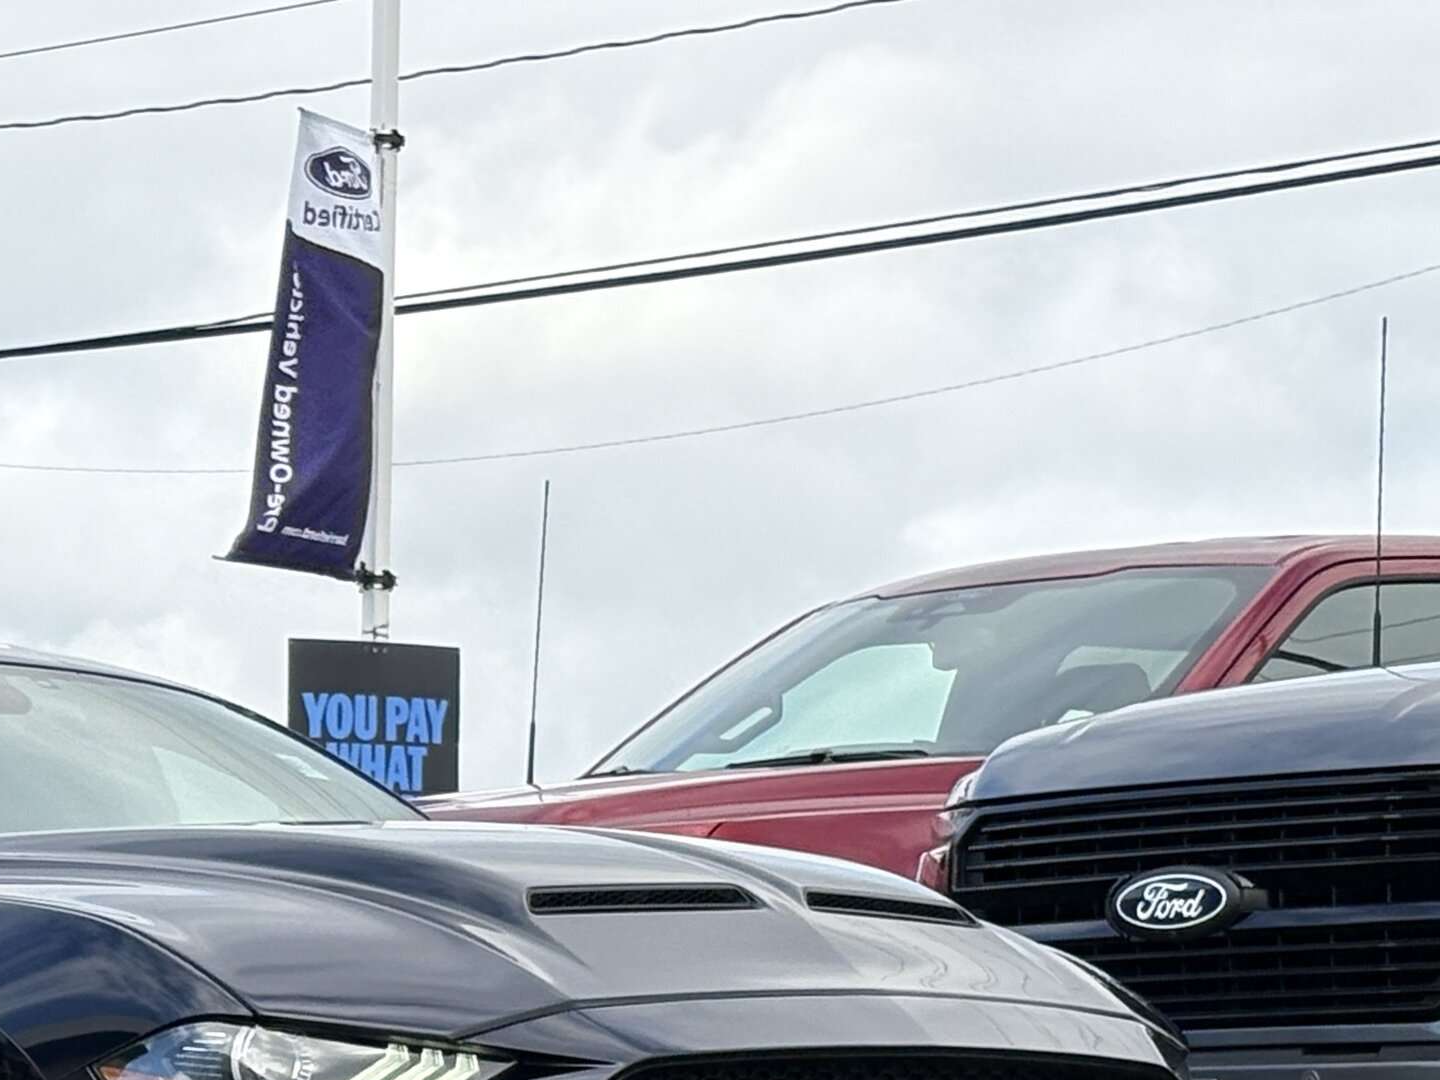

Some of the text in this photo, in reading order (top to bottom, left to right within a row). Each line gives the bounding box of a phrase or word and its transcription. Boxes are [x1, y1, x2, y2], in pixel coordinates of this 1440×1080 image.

[302, 692, 448, 744] YOU PAY
[1136, 882, 1205, 920] Ford
